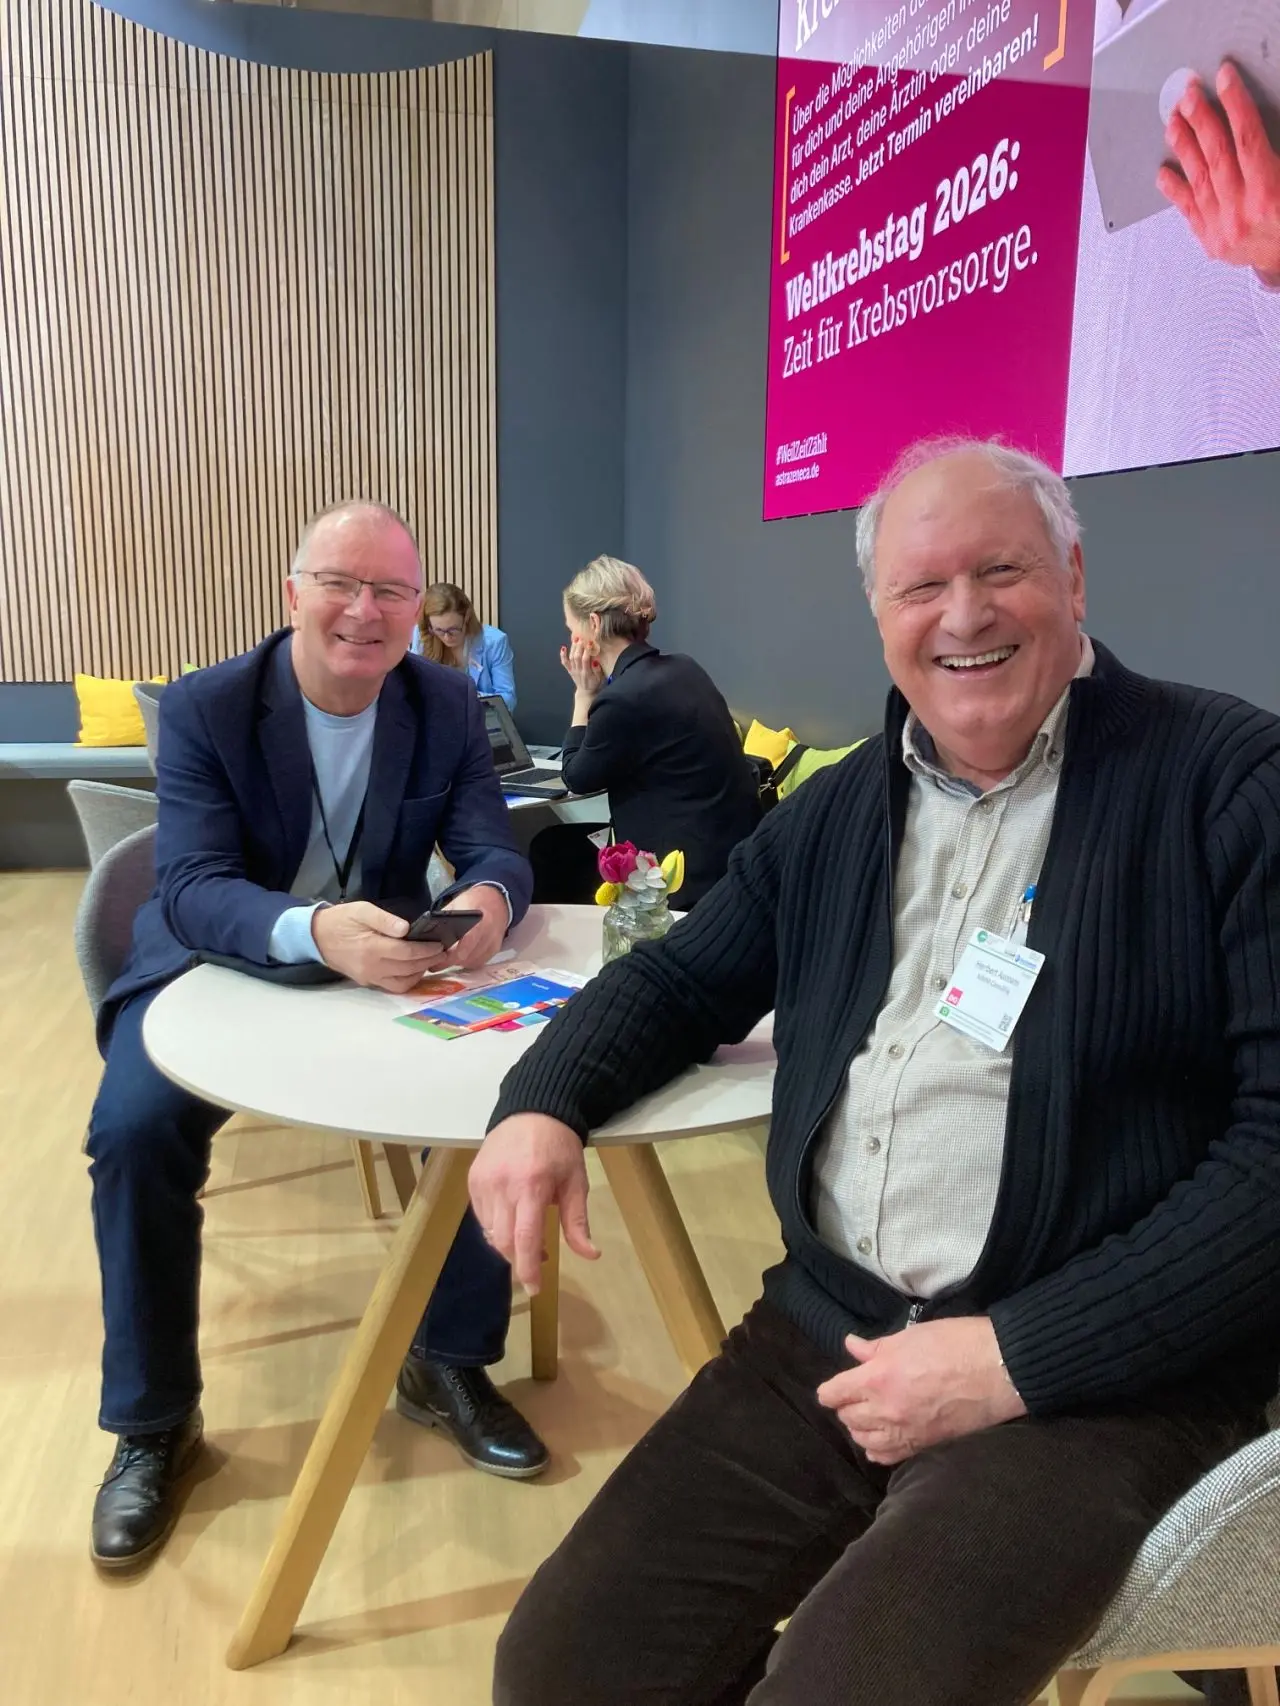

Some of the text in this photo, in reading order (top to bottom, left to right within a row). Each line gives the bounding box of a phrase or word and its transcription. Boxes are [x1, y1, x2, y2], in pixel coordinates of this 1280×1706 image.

[789, 12, 1038, 238] Krankenkasse. Jetzt Termin vereinbaren!
[791, 172, 808, 204] dich
[810, 155, 828, 187] dein
[831, 133, 854, 170] Arzt,
[856, 105, 887, 147] deine
[889, 69, 926, 120] Ärztin
[930, 36, 963, 83] oder
[967, 0, 1010, 51] deine
[792, 142, 804, 170] für
[804, 123, 823, 157] dich
[825, 101, 843, 139] und
[845, 78, 873, 120] deine
[875, 0, 955, 92] Angehörigen
[793, 4, 906, 135] Über die Möglichkeiten
[783, 224, 1038, 379] Zeit für Krebsvorsorge.
[785, 138, 1020, 322] Weltkrebstag 2026:
[775, 462, 820, 487] astrazeneca.de
[776, 432, 827, 466] #WeilZeitZählt
